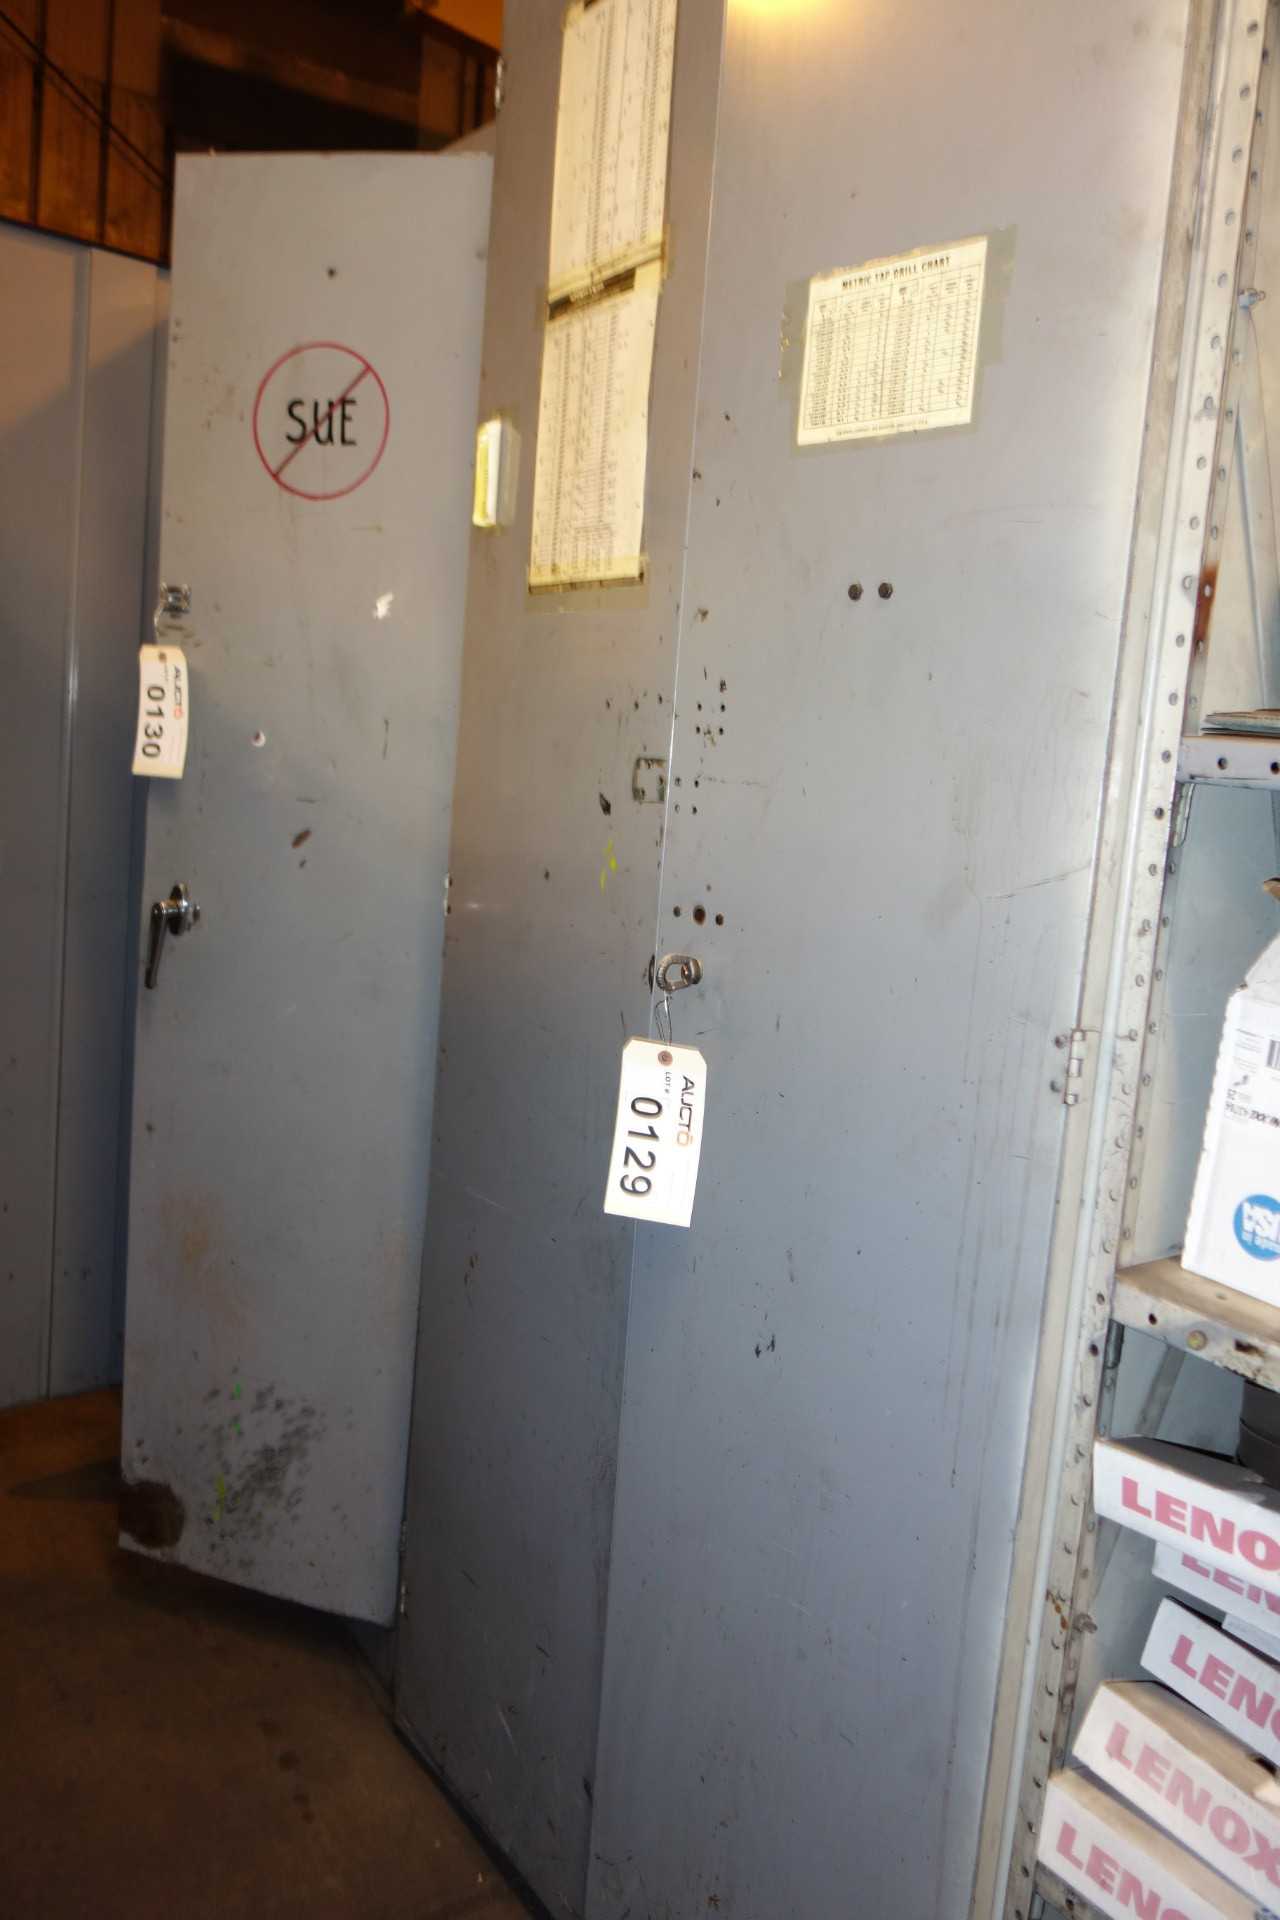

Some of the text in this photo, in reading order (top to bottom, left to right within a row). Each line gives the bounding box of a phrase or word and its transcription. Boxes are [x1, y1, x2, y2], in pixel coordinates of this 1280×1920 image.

[842, 256, 950, 290] METRIC TAP DRILL CHART
[286, 398, 357, 446] SUE
[142, 685, 166, 758] 0130
[619, 1096, 663, 1198] 0129
[1171, 1634, 1280, 1743] LEN
[1056, 1821, 1193, 1920] LEN
